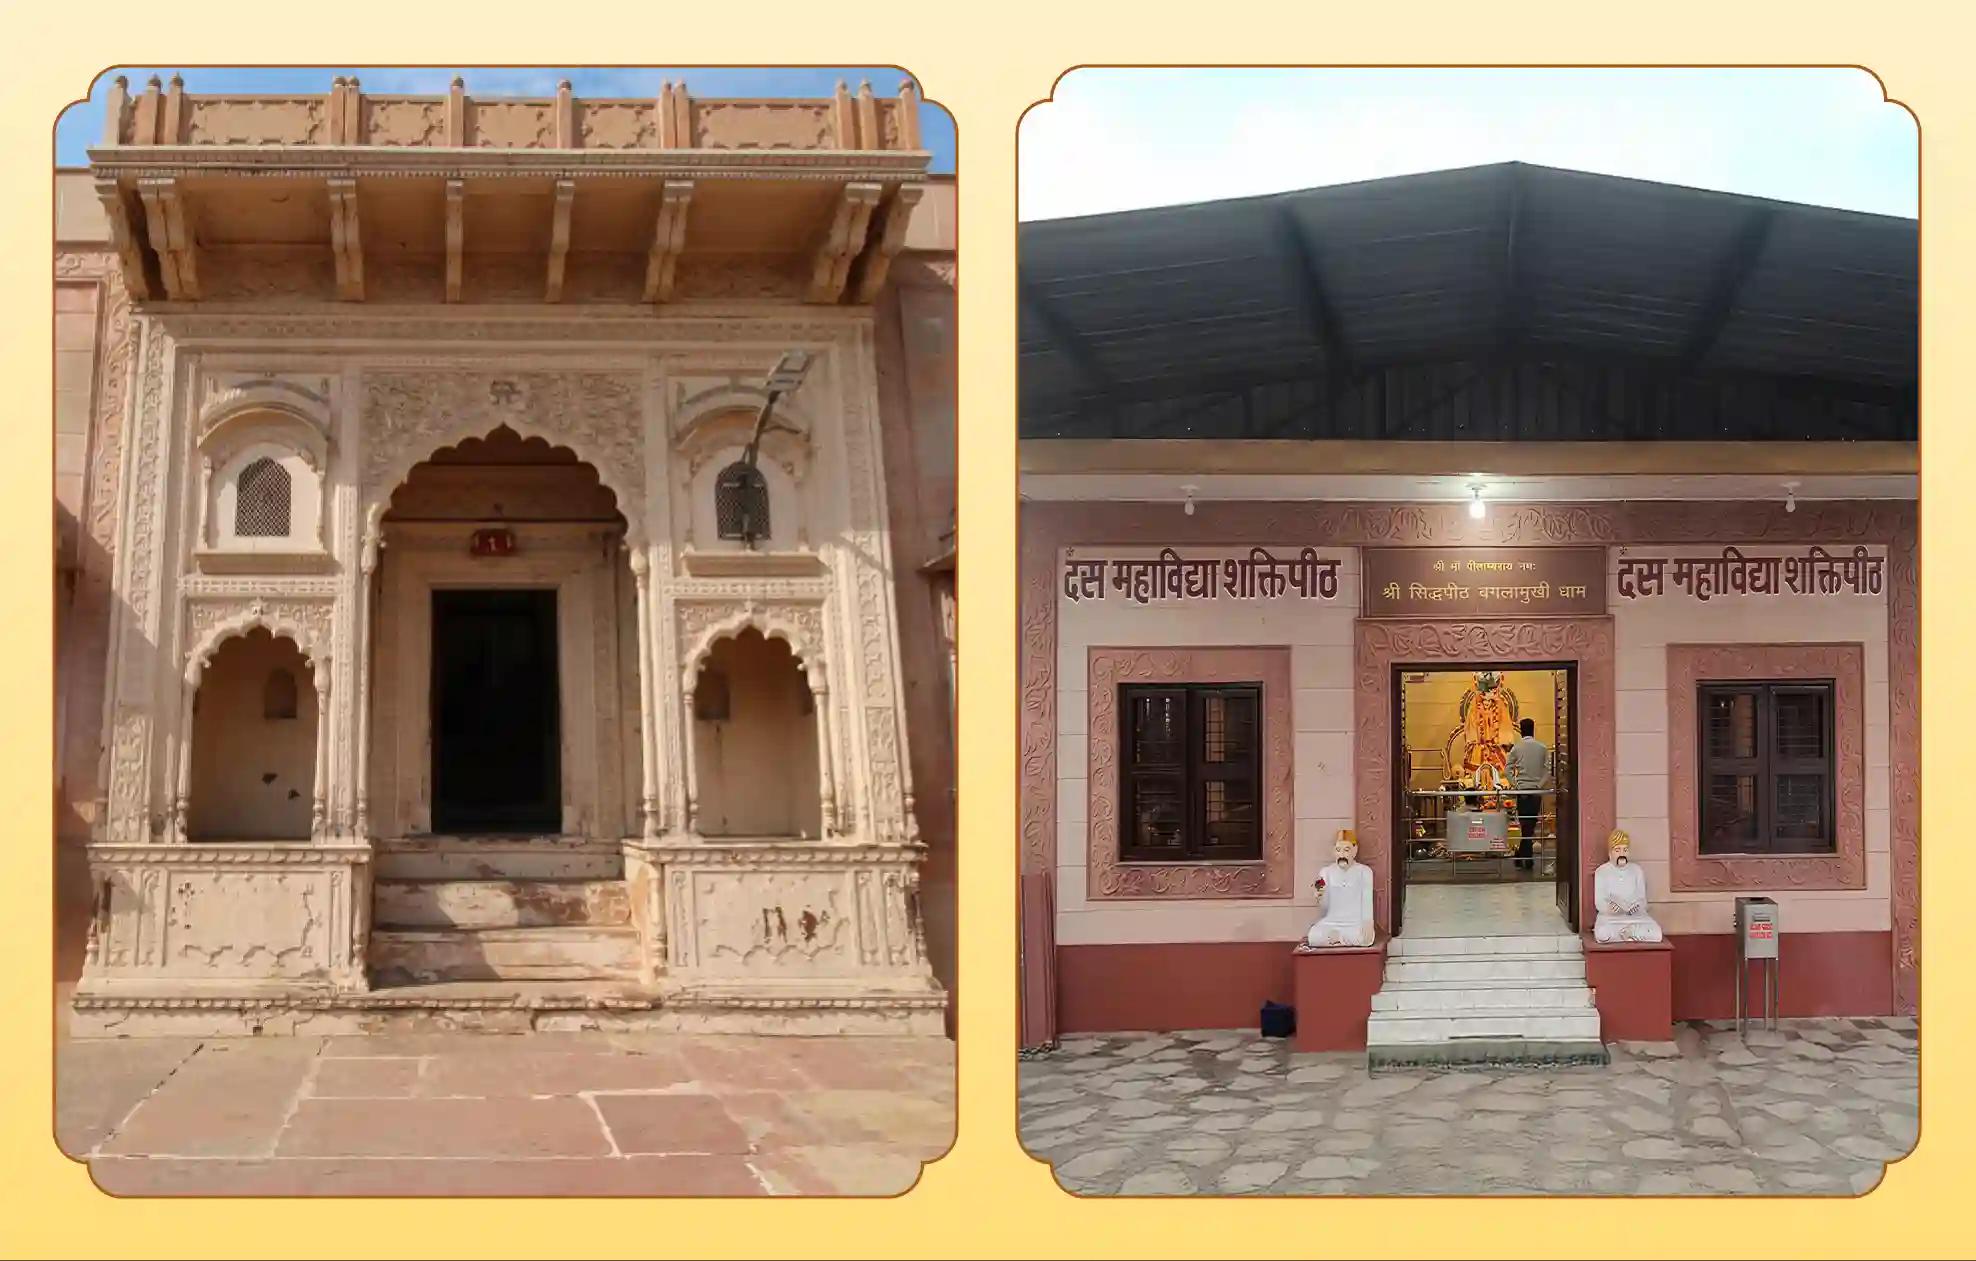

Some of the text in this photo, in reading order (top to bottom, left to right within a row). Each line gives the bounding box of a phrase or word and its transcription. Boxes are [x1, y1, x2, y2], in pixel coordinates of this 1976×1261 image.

[1065, 546, 1342, 604] दस महाविद्या शक्तिपीठ
[1382, 582, 1401, 600] श्री
[1408, 582, 1470, 601] सिद्धपीठ
[1558, 584, 1587, 600] धाम
[1617, 545, 1886, 602] दस महाविद्या शक्तिपीठ
